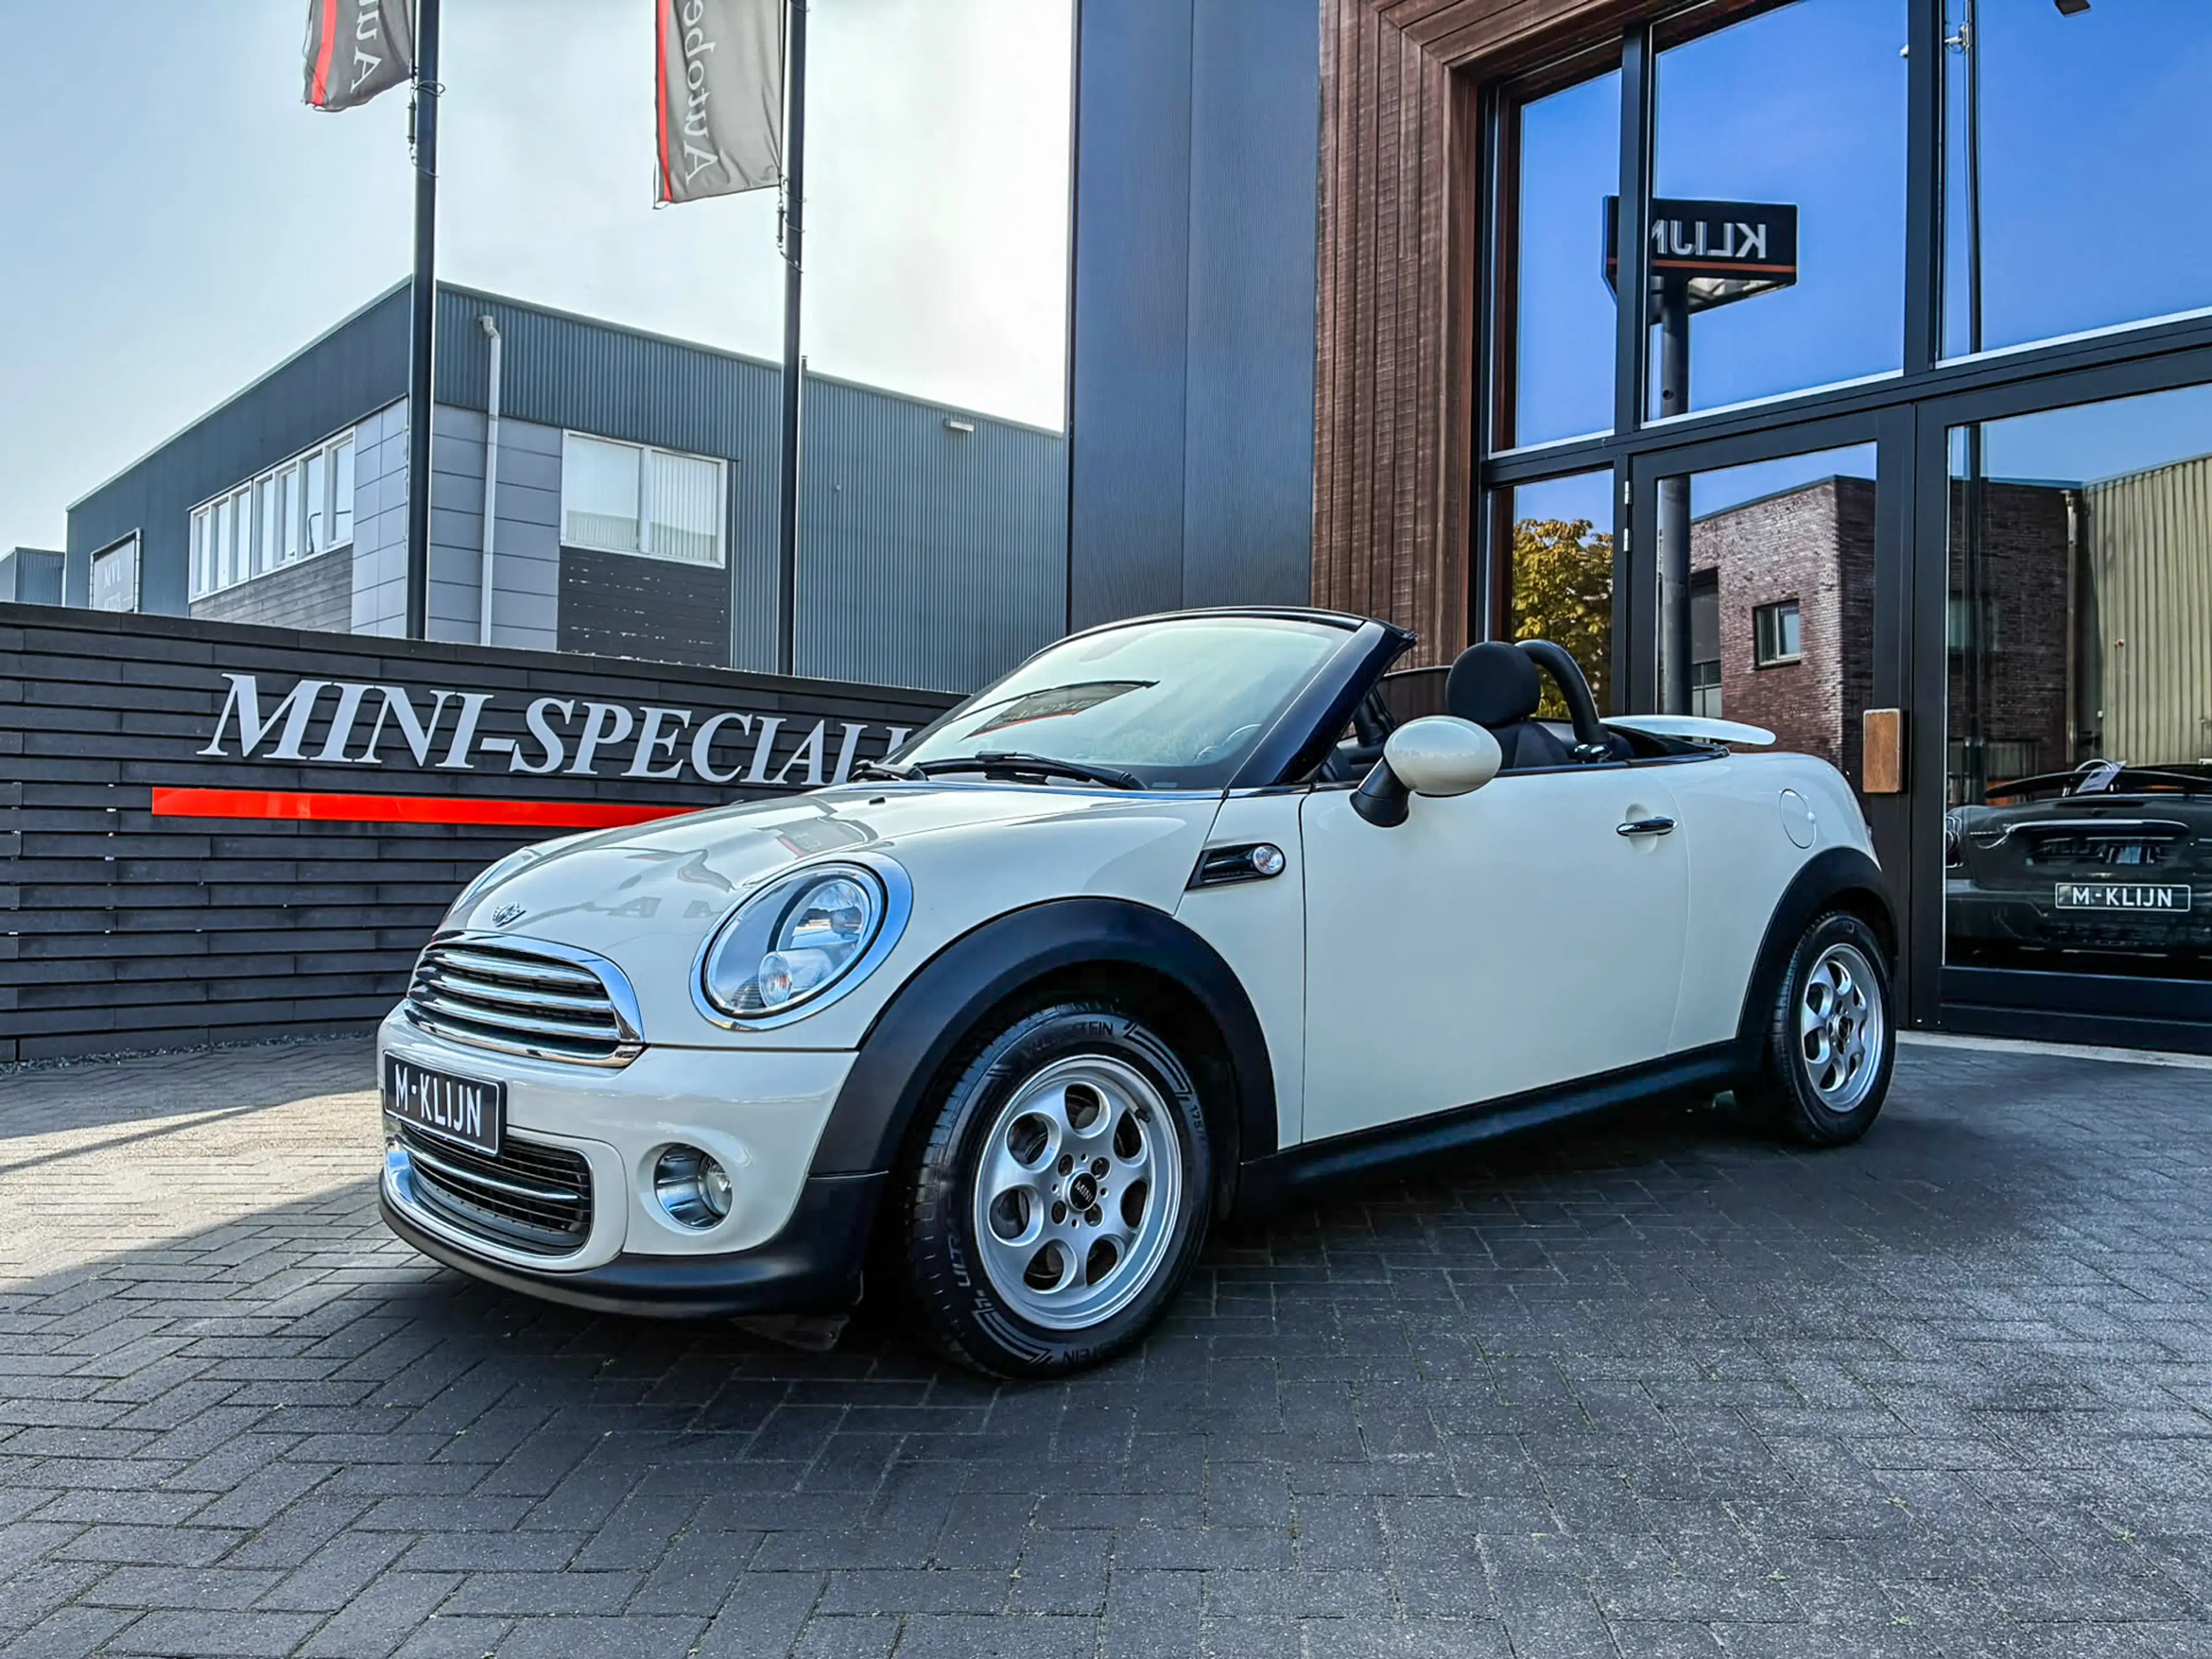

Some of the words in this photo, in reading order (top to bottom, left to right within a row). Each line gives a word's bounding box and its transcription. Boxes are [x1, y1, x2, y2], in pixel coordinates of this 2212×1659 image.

[2073, 886, 2172, 907] M-KLIJN
[395, 1063, 482, 1138] M-KLIJN
[1074, 1180, 1094, 1203] MINI
